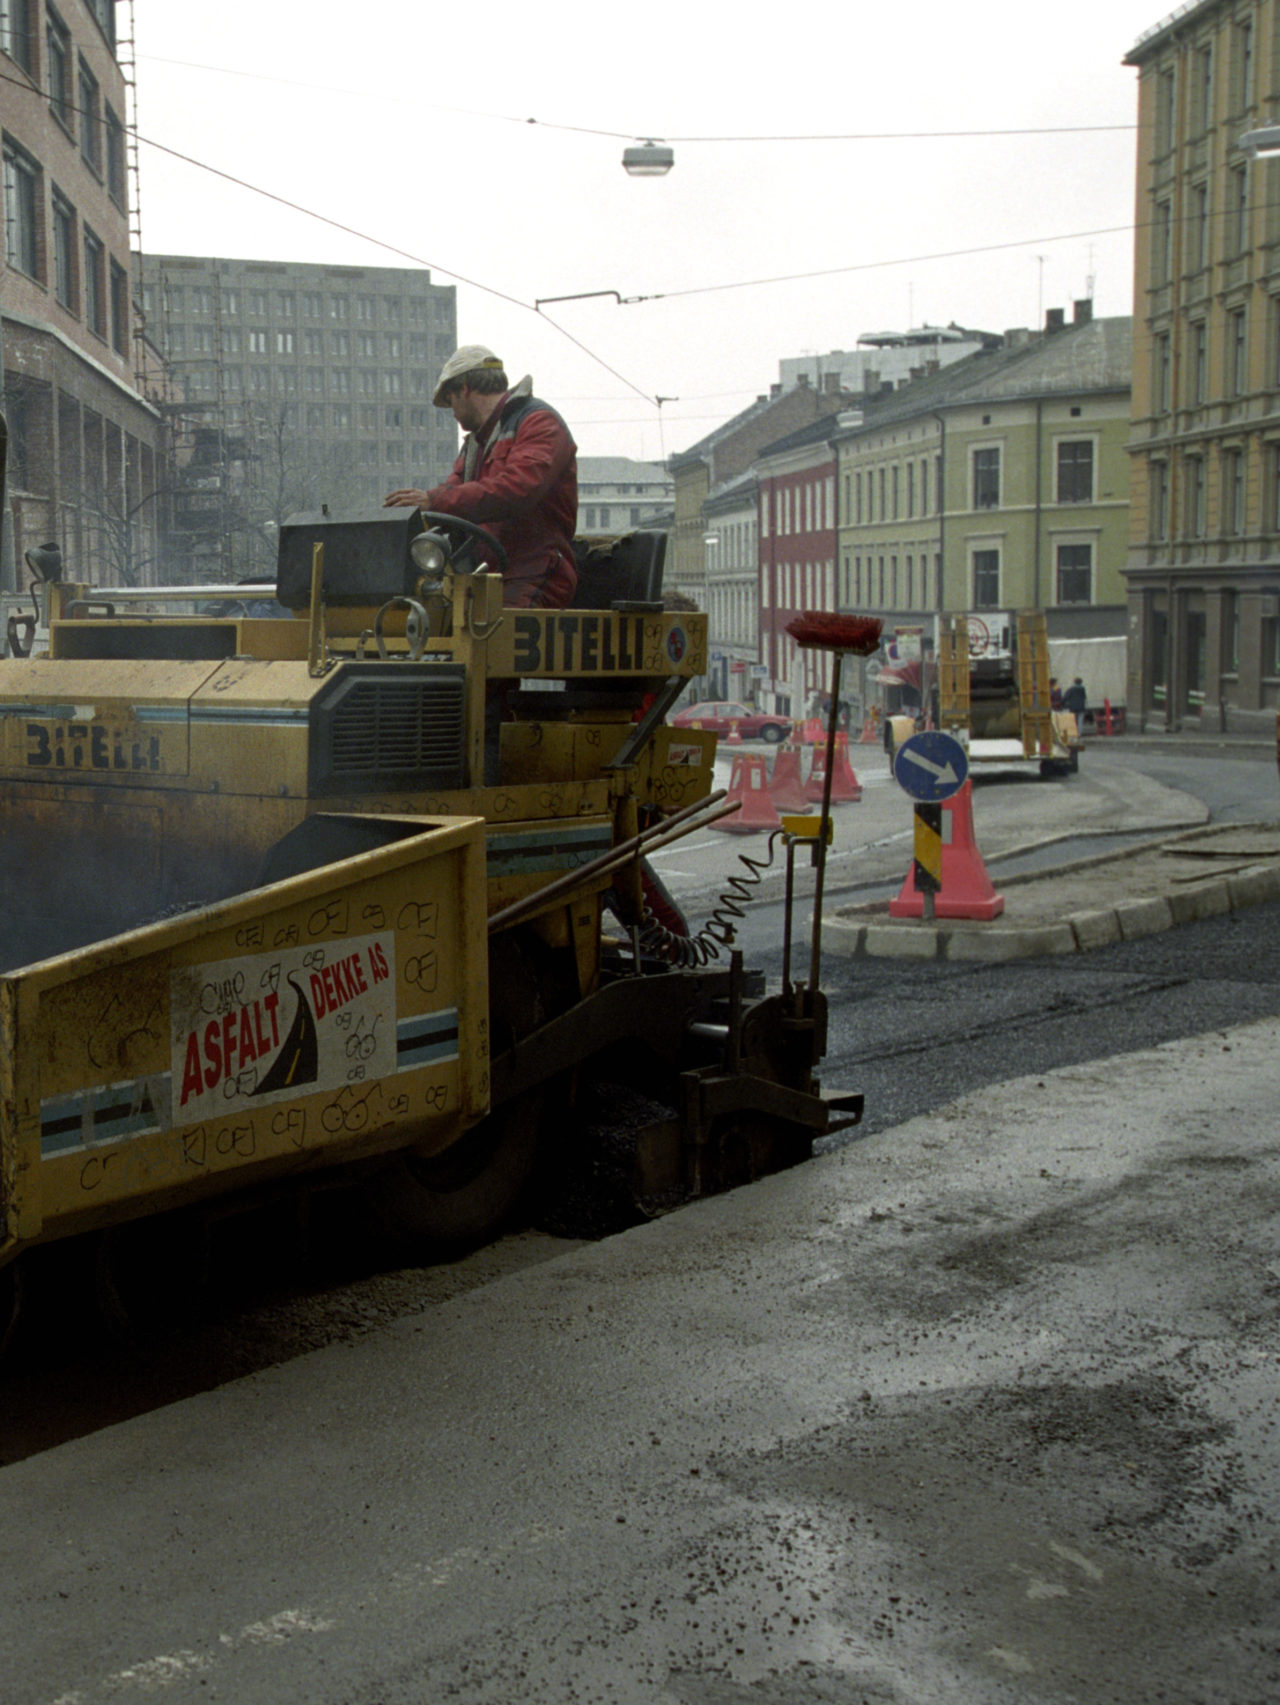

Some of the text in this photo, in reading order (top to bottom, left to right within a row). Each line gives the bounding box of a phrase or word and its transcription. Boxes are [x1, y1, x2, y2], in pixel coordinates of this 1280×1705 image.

[514, 616, 644, 672] BITELLI
[180, 992, 280, 1107] ASFALT
[309, 952, 368, 1021] DEKKE
[367, 942, 389, 984] AS
